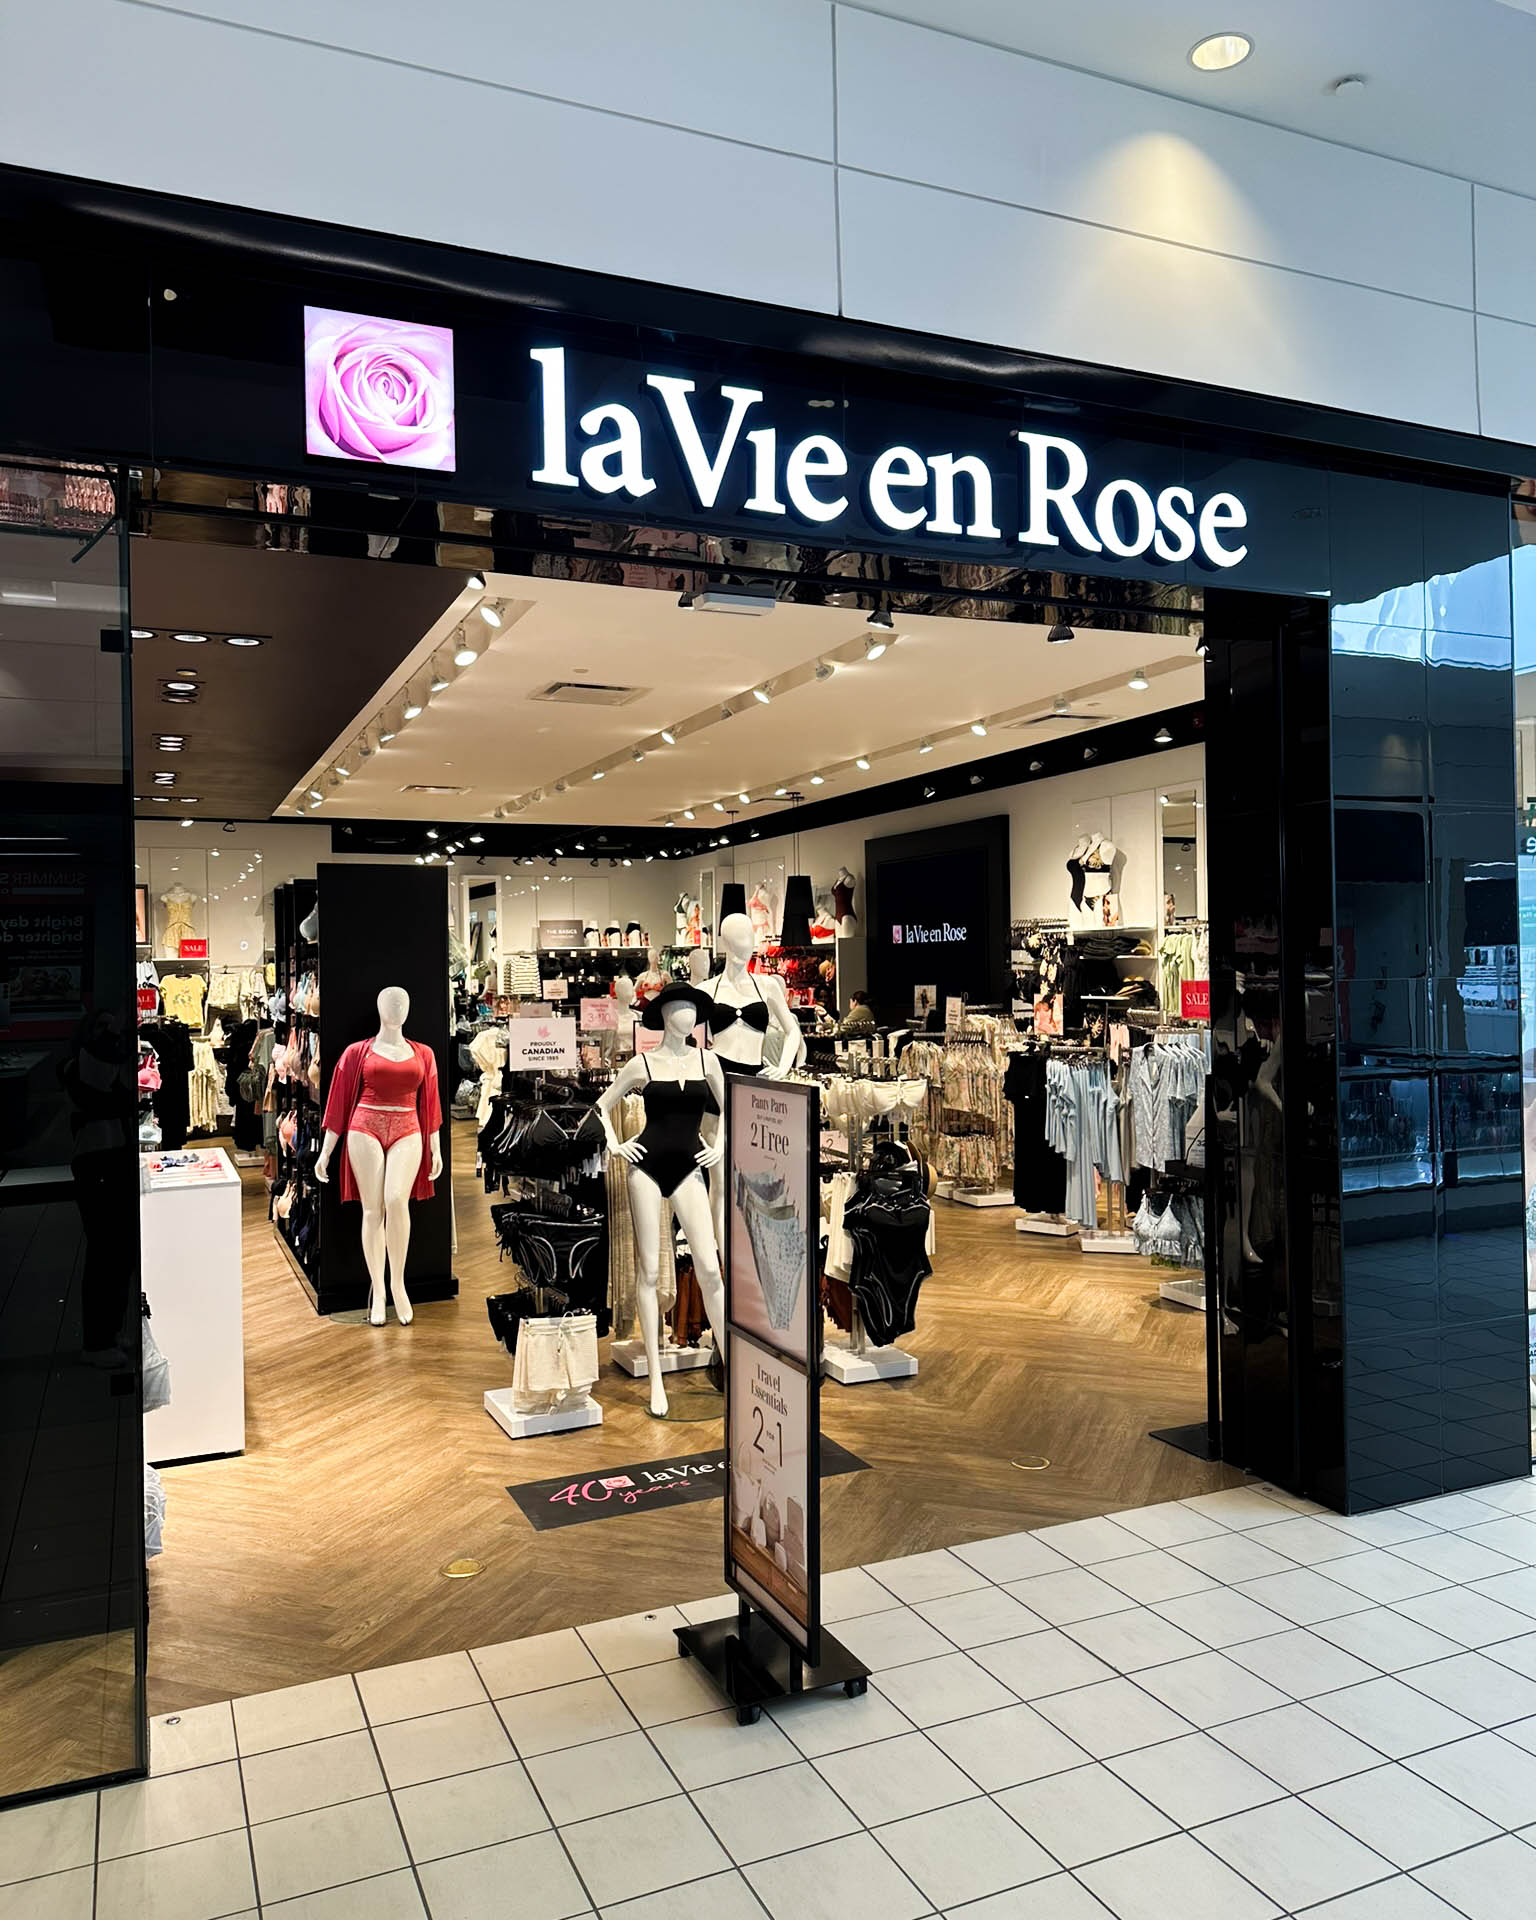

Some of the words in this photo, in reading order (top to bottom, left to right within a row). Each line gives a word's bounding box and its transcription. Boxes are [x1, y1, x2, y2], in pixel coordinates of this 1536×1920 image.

[868, 445, 1002, 540] en
[1017, 430, 1250, 569] Rose
[929, 928, 942, 943] en
[942, 922, 967, 942] Rose
[183, 944, 204, 952] SALE
[1185, 992, 1209, 1006] SALE
[521, 1047, 565, 1055] CANADIAN
[770, 1098, 788, 1115] Party
[750, 1121, 758, 1147] 2
[761, 1124, 790, 1156] Free
[757, 1363, 781, 1393] Travel
[751, 1379, 788, 1417] Essentials
[752, 1406, 765, 1454] 2
[776, 1421, 783, 1468] 1
[549, 1480, 613, 1506] 40
[619, 1479, 692, 1504] years
